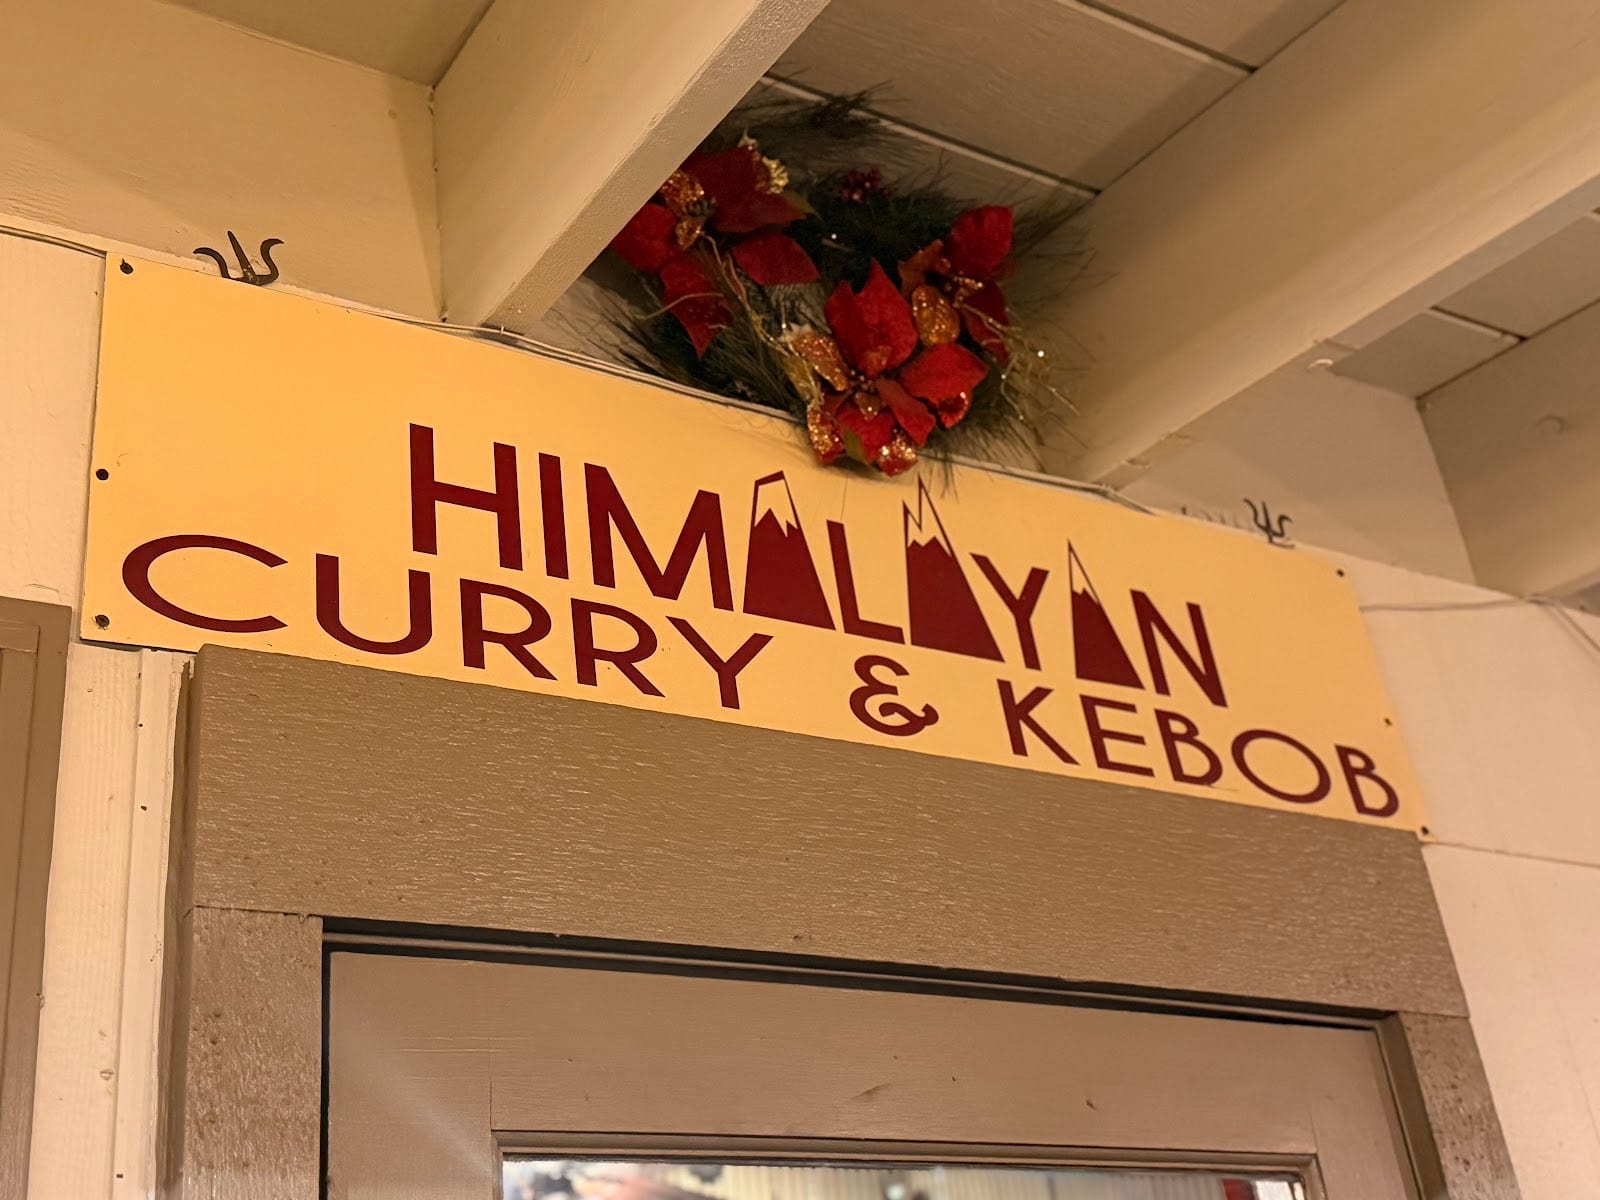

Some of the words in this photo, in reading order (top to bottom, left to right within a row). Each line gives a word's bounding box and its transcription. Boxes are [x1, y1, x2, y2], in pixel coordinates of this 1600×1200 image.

[122, 534, 774, 710] CURRY
[849, 655, 939, 737] &
[997, 679, 1399, 817] KEBOB
[409, 422, 1228, 709] HIMALAYAN
